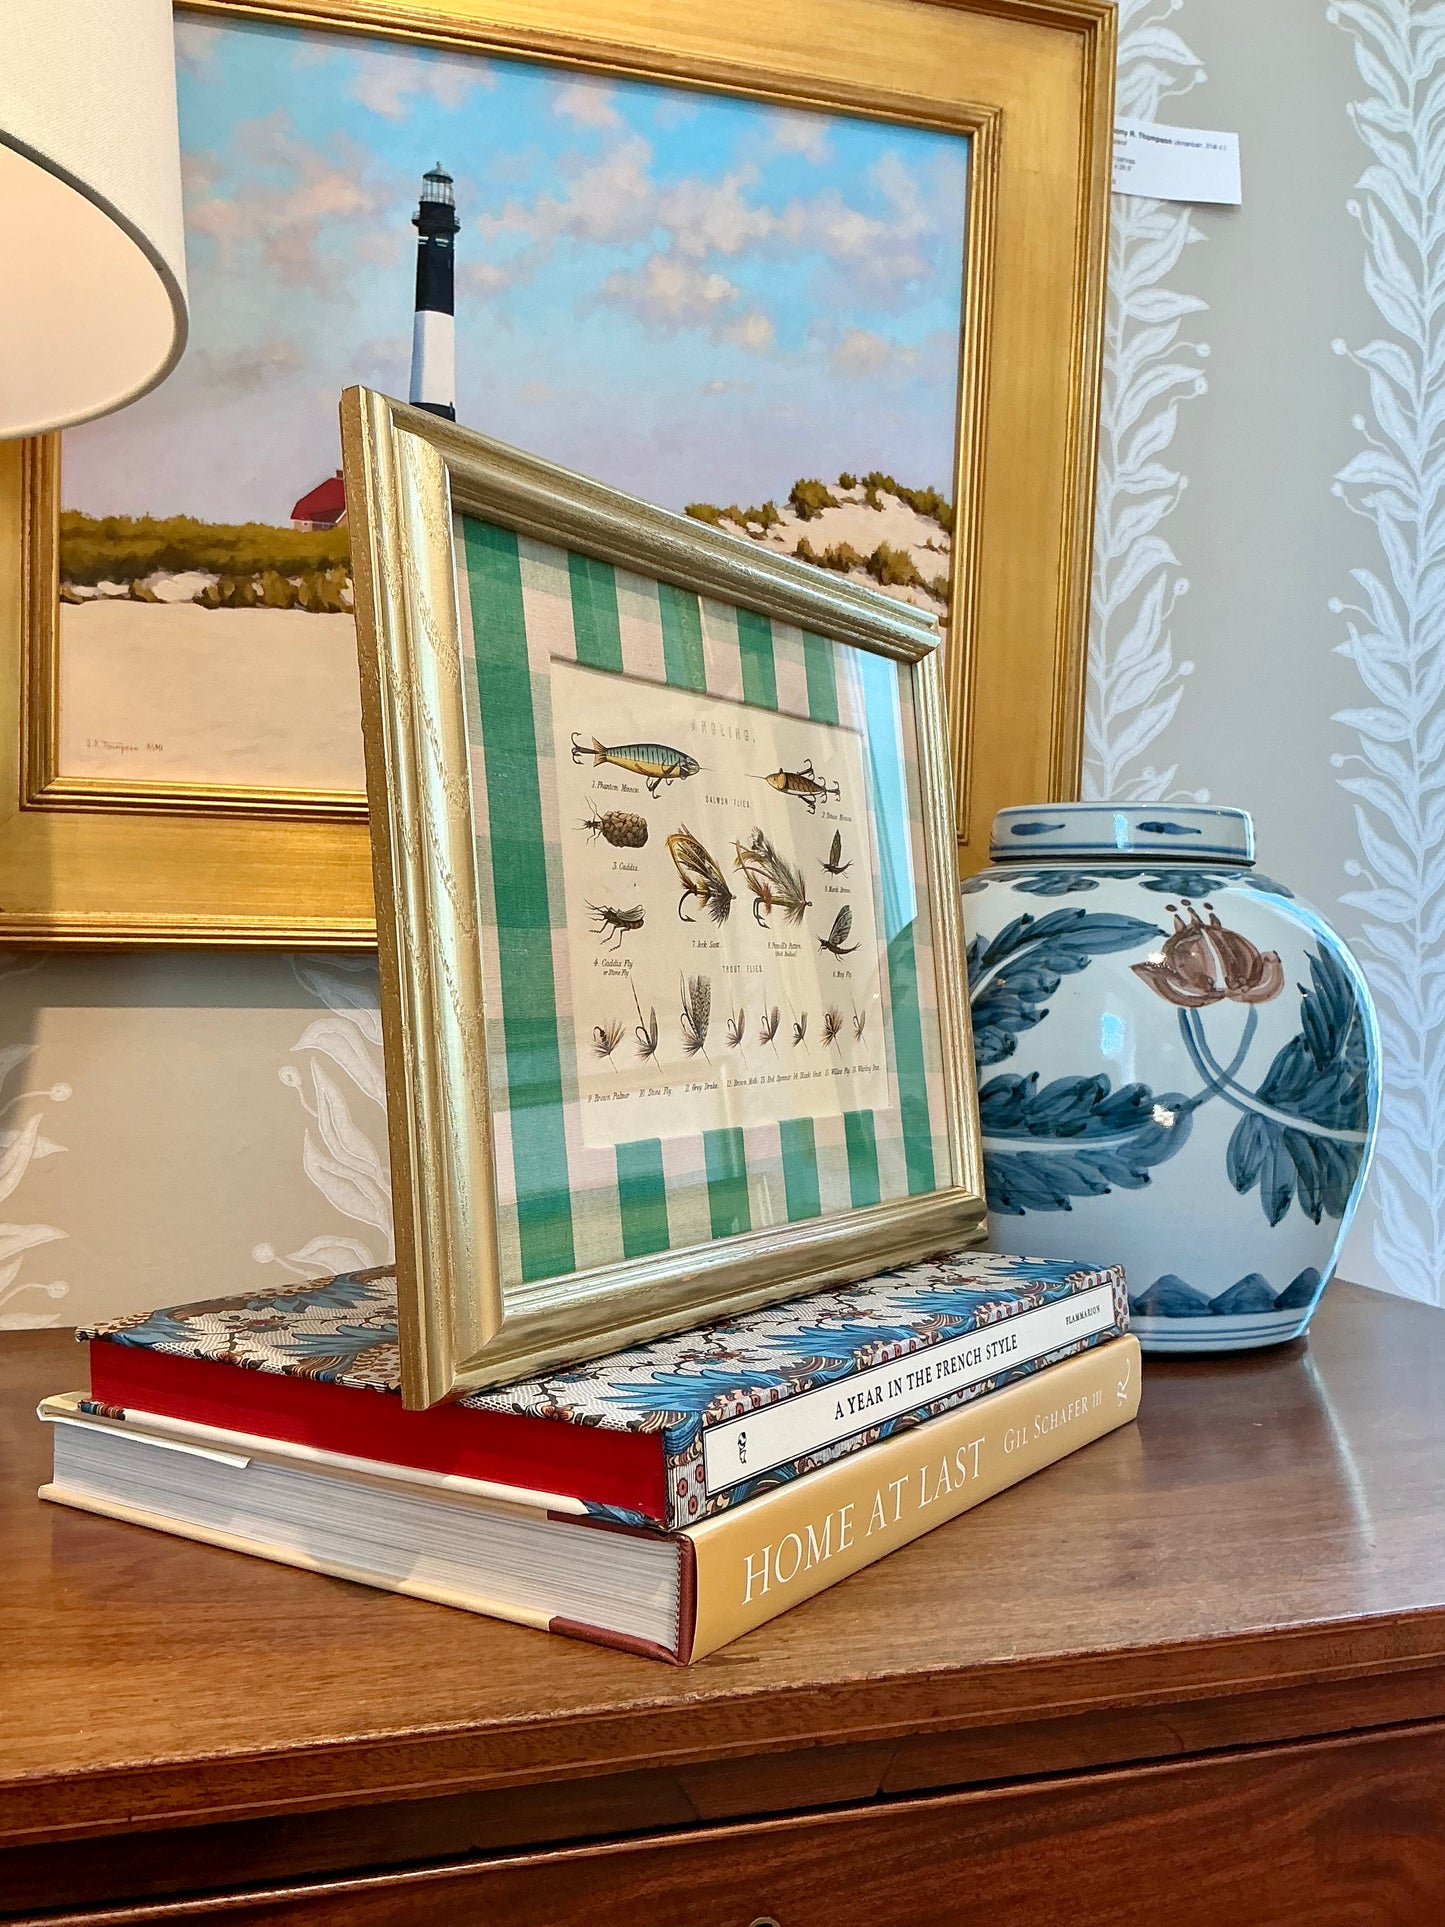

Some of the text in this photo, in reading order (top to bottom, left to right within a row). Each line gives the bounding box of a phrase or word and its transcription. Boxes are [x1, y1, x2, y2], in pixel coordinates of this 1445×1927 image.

[706, 794, 728, 805] SALMON
[1065, 1304, 1102, 1326] FLAMMARION
[834, 1333, 1018, 1420] A YEAR IN THE FRENCH STYLE
[1092, 1389, 1102, 1408] III
[741, 1436, 986, 1606] HOME AT LAST
